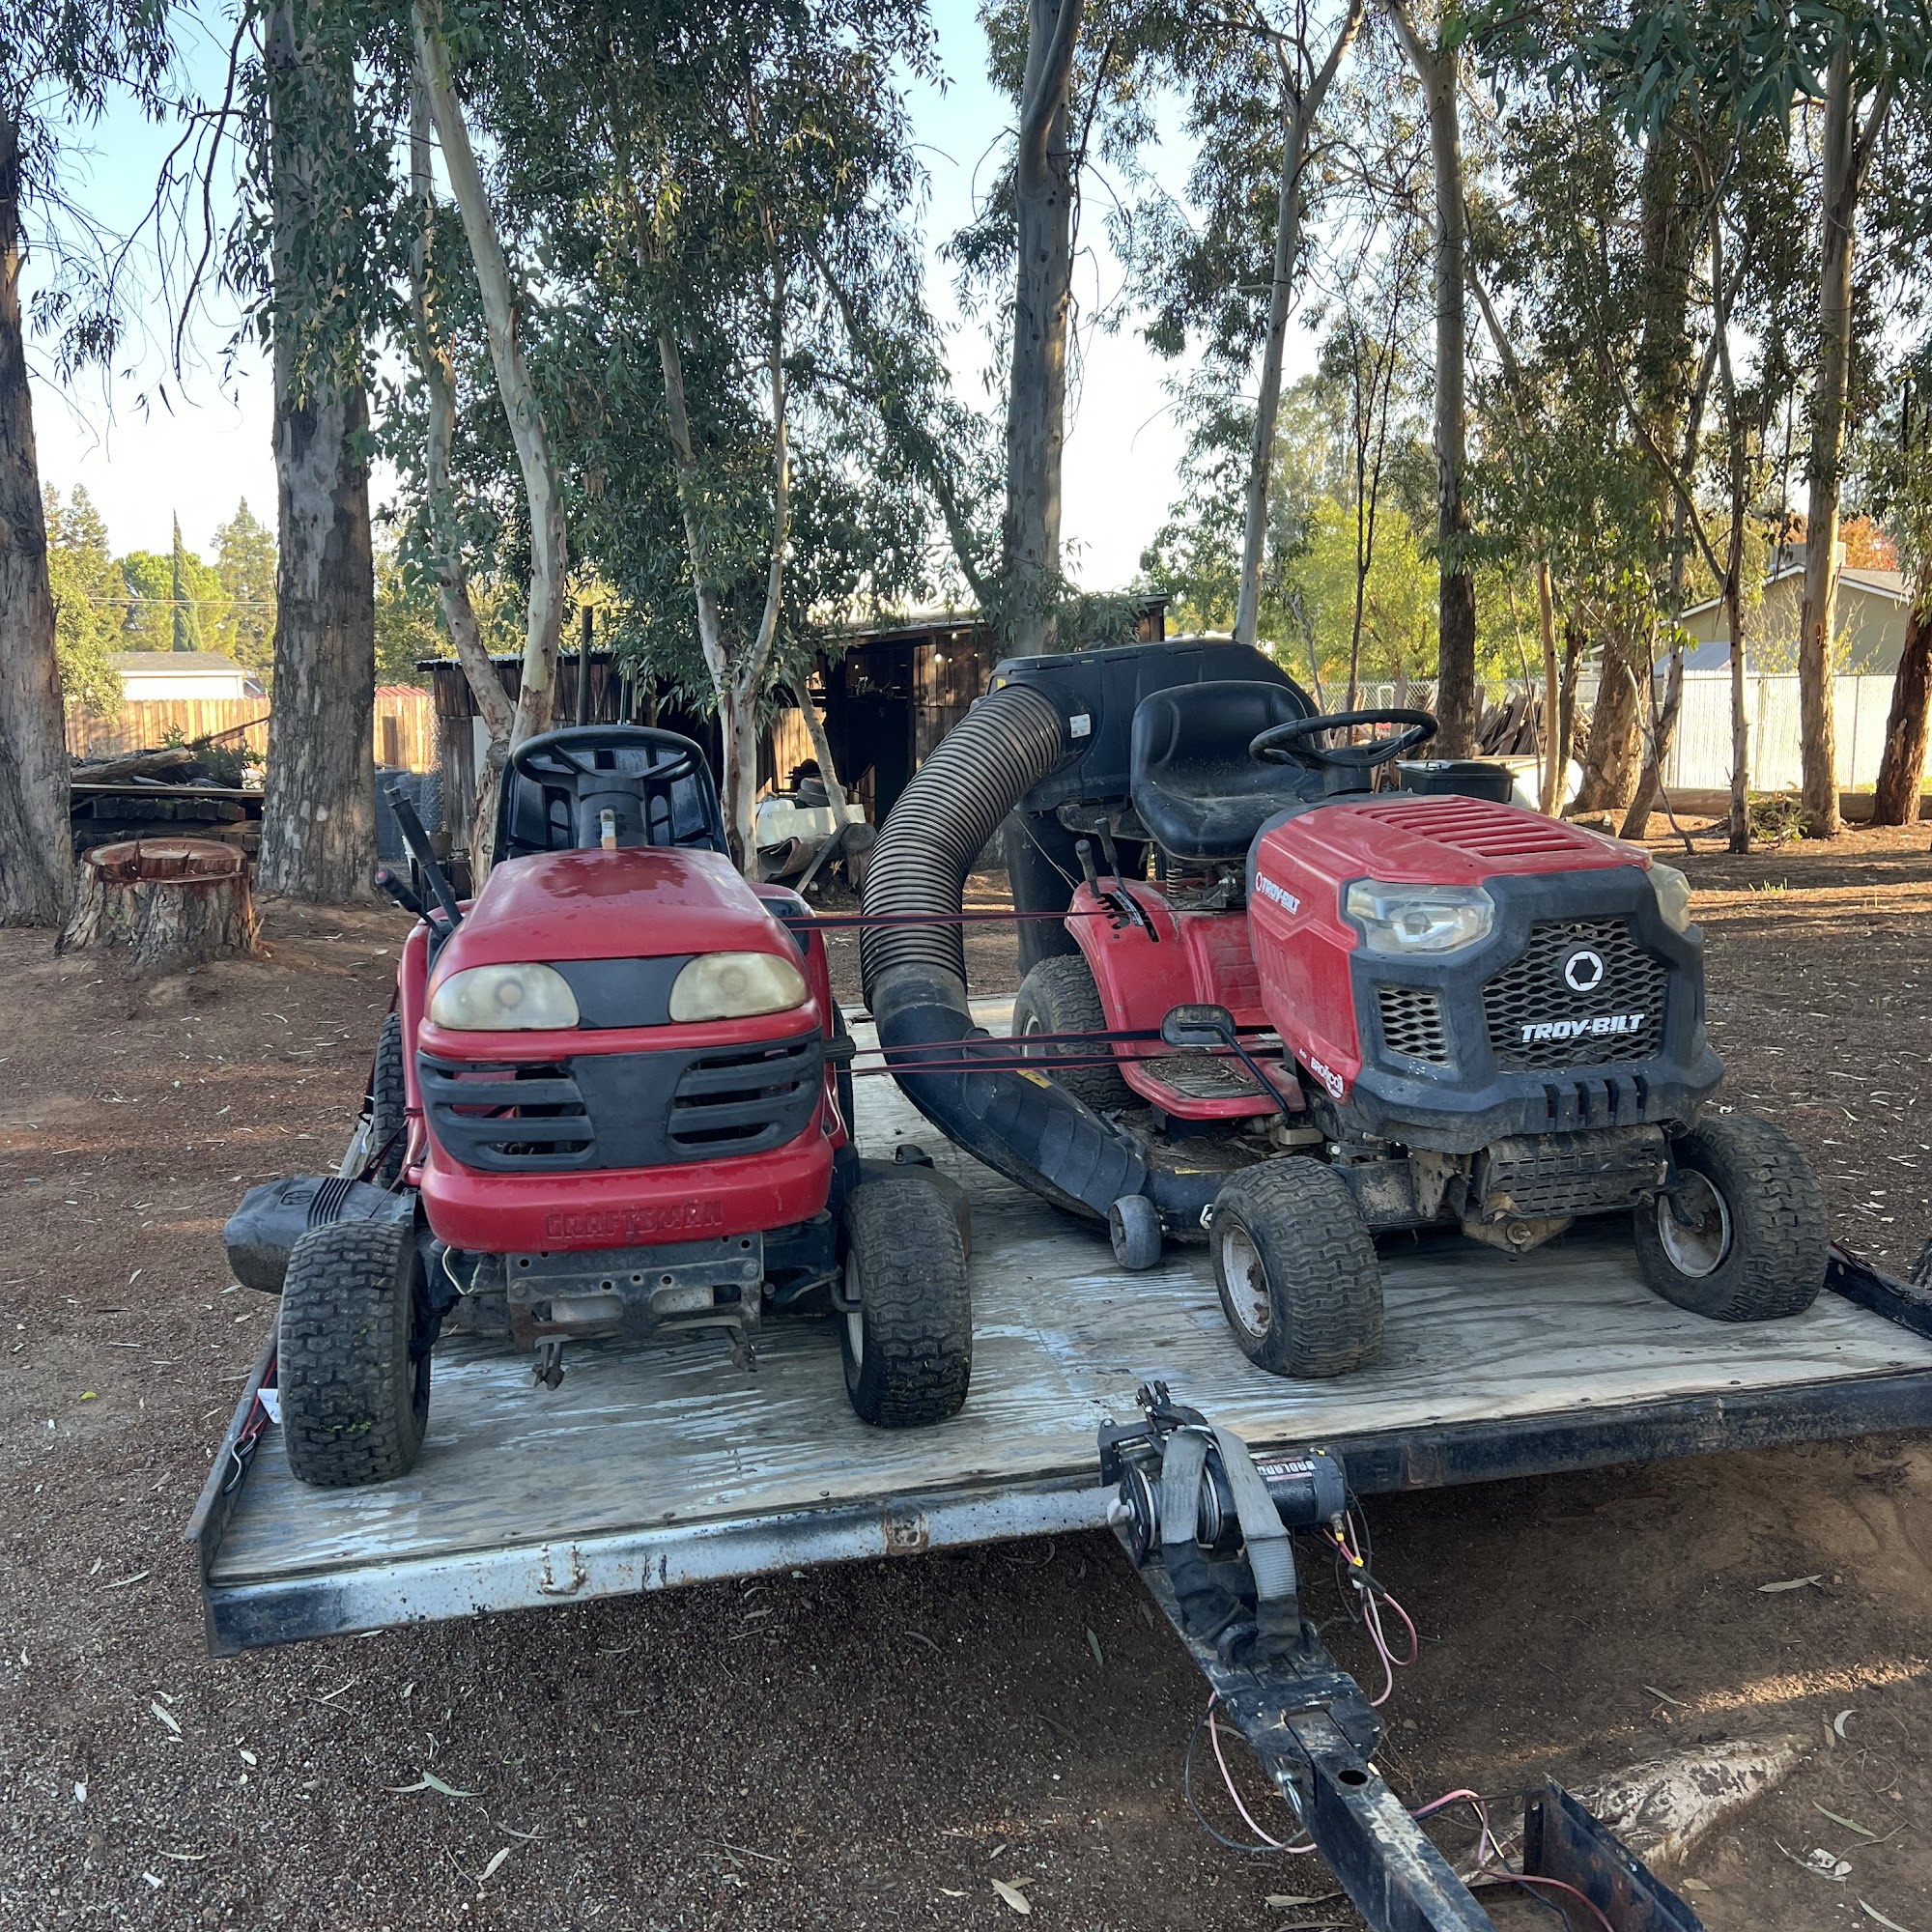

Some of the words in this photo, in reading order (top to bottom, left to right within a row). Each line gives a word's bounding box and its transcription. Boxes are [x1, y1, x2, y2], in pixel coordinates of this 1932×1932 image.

[1261, 876, 1301, 915] TROY-BILT
[1520, 1013, 1645, 1042] TROY-BILT
[546, 1201, 723, 1239] CRAFTSMAN
